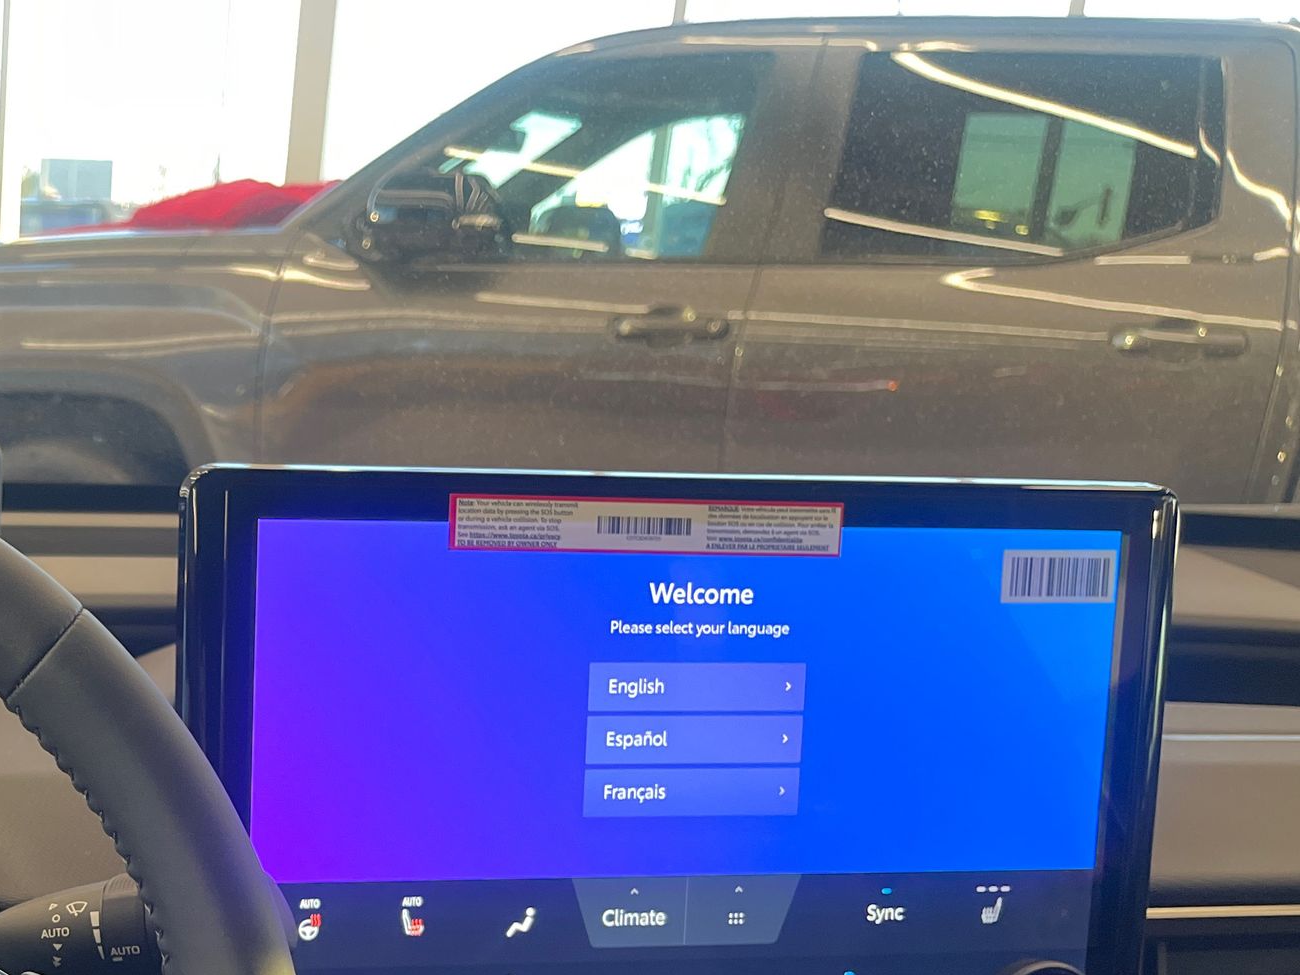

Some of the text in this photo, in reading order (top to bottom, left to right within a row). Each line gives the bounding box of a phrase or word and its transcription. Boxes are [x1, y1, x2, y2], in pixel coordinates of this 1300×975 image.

[649, 581, 755, 605] Welcome
[610, 620, 790, 639] Please select your language
[607, 677, 665, 698] English
[605, 730, 668, 750] Español
[603, 783, 666, 804] Français
[299, 898, 321, 909] AUTO
[402, 896, 424, 907] AUTO
[602, 908, 667, 927] Climate
[866, 903, 906, 925] Sync
[41, 926, 70, 940] AUTO
[110, 945, 141, 956] AUTO
